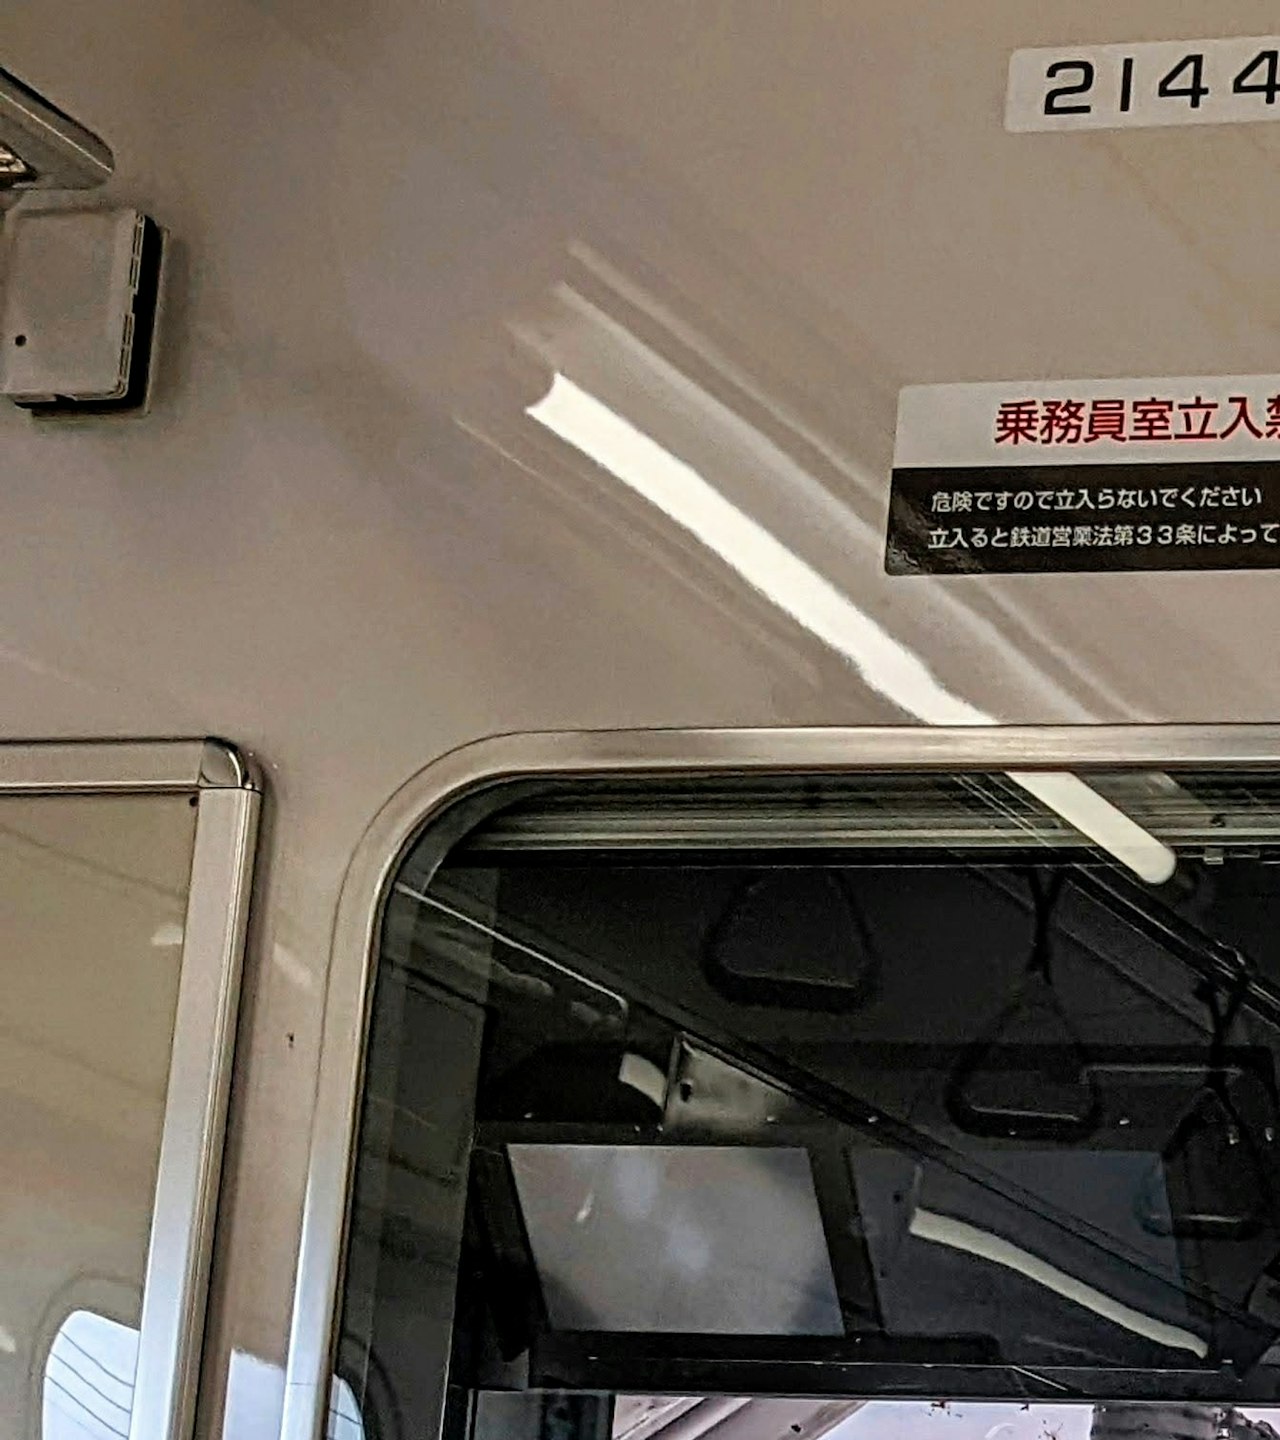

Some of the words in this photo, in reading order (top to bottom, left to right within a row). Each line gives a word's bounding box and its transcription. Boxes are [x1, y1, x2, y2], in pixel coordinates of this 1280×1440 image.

[931, 485, 1262, 513] 危険ですので立入らないでください
